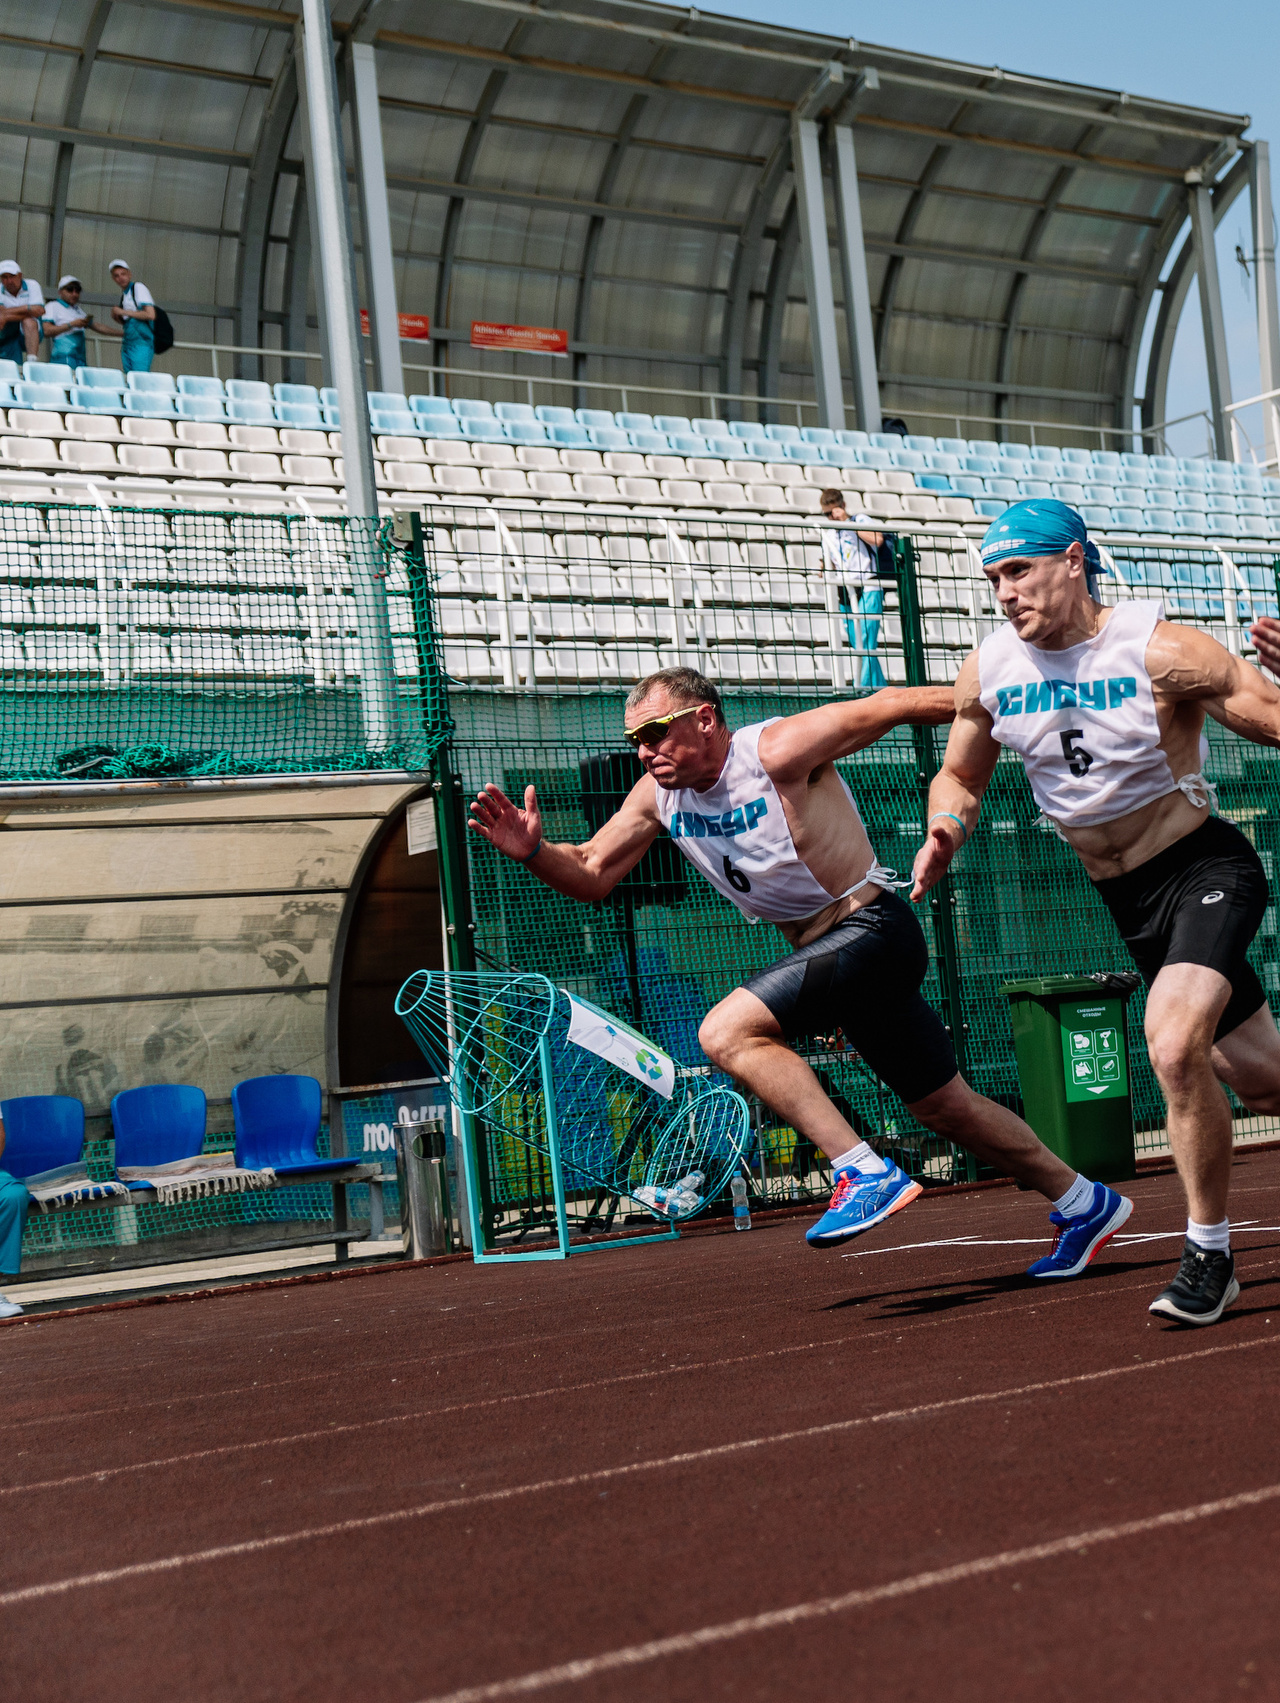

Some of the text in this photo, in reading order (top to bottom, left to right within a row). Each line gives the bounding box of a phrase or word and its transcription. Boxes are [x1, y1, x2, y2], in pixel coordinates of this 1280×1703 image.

[996, 677, 1137, 717] СИБУР
[1060, 729, 1094, 778] 5
[670, 797, 769, 839] СИБУР
[722, 854, 752, 894] 6
